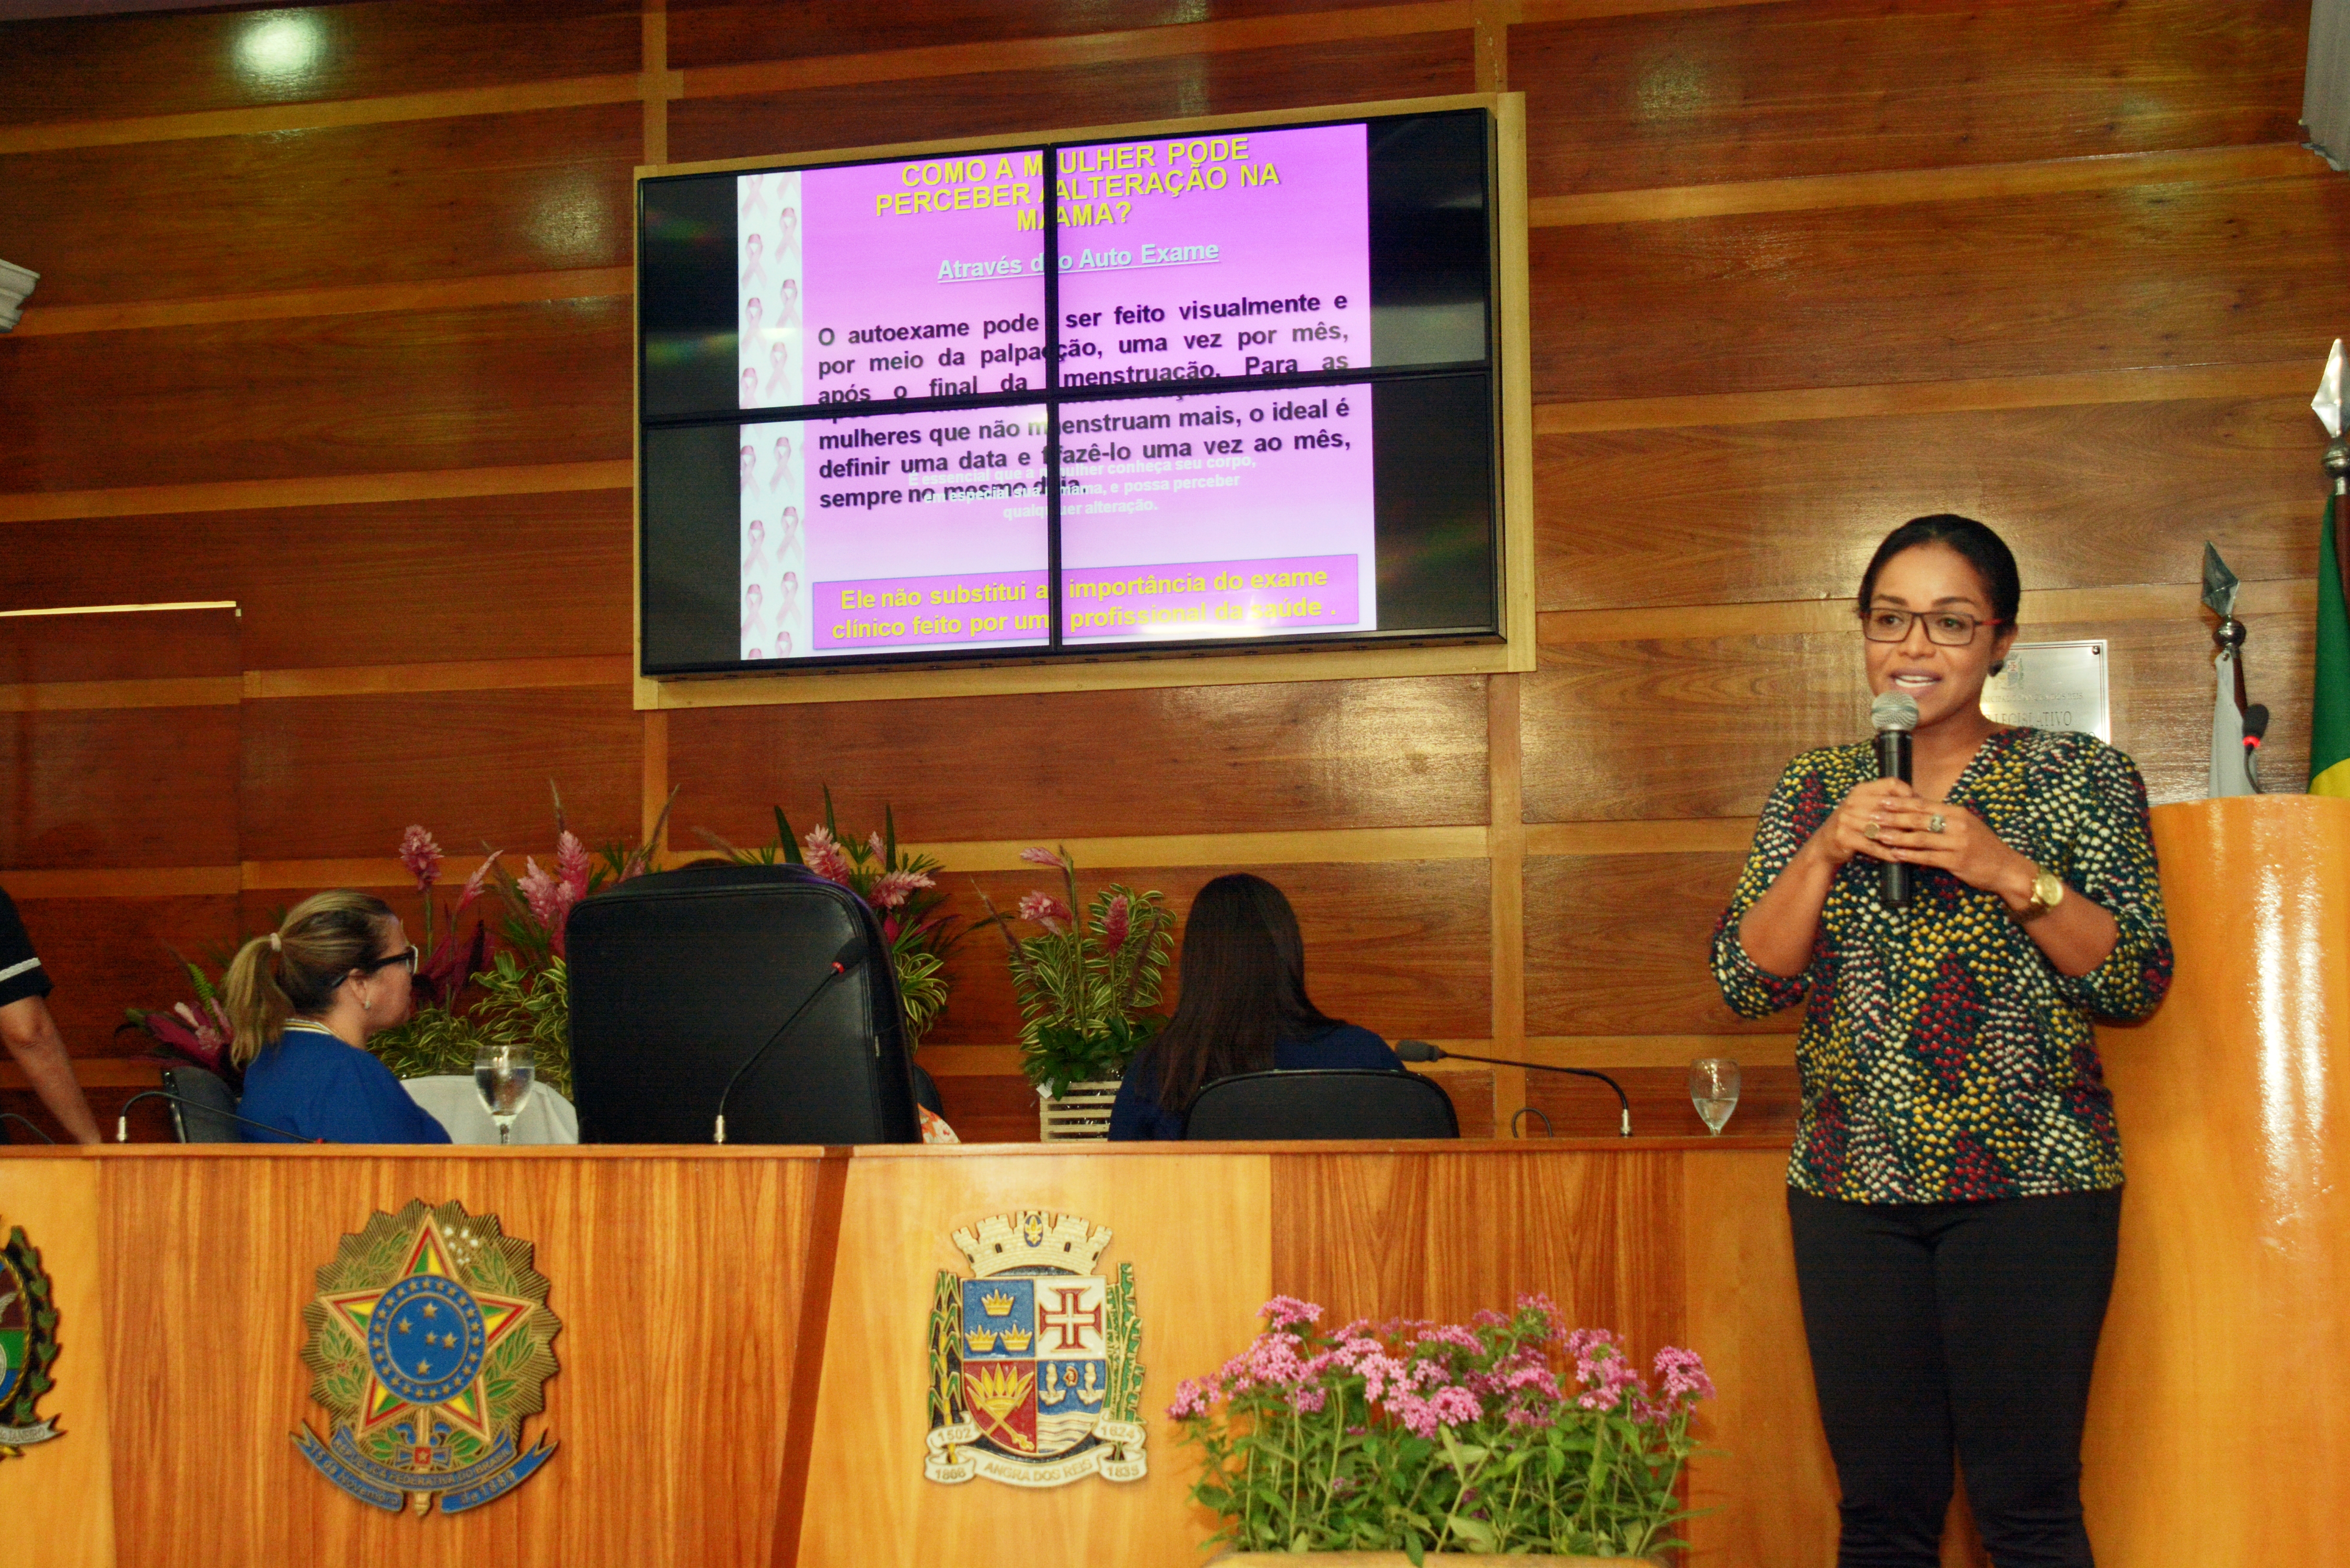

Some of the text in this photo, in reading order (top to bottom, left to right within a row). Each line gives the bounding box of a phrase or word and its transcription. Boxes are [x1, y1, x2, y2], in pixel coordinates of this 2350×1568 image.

[902, 137, 1249, 187] COMO A MULHER PODE
[876, 163, 1280, 216] PERCEBER ALTERAÇÃO NA
[1017, 201, 1132, 231] MAMA?
[937, 243, 1219, 281] Através do Auto Exame
[818, 294, 1348, 346] O autoexame pode ser feito visualmente e
[818, 322, 1349, 380] por meio da palpação, uma vez por mês,
[894, 385, 907, 400] o
[929, 376, 977, 397] final
[1000, 373, 1029, 393] da
[1245, 355, 1298, 377] Para
[1322, 355, 1349, 372] as
[820, 397, 1350, 449] mulheres que não menstruam mais, o ideal é
[819, 429, 1351, 478] definir uma data e fazê-lo uma vez ao mês,
[909, 455, 1257, 486] É essencial que a mulher conheça seu corpo,
[820, 490, 902, 510] sempre
[909, 487, 935, 503] no
[944, 482, 1028, 500] mesmo
[924, 475, 1241, 504] em especial sua mama, e possa perceber
[1003, 499, 1158, 521] qualquer alteração.
[842, 571, 1328, 609] Ele não substitui a importância do exame
[833, 619, 905, 639] clínico
[913, 615, 962, 635] feito
[970, 617, 1008, 637] por
[1015, 614, 1049, 630] um
[1070, 601, 1205, 632] profissional
[1215, 601, 1243, 621] da
[1250, 597, 1322, 618] saúde
[938, 1428, 972, 1442] 1502
[984, 1458, 1092, 1482] ANGRA DOS REIS
